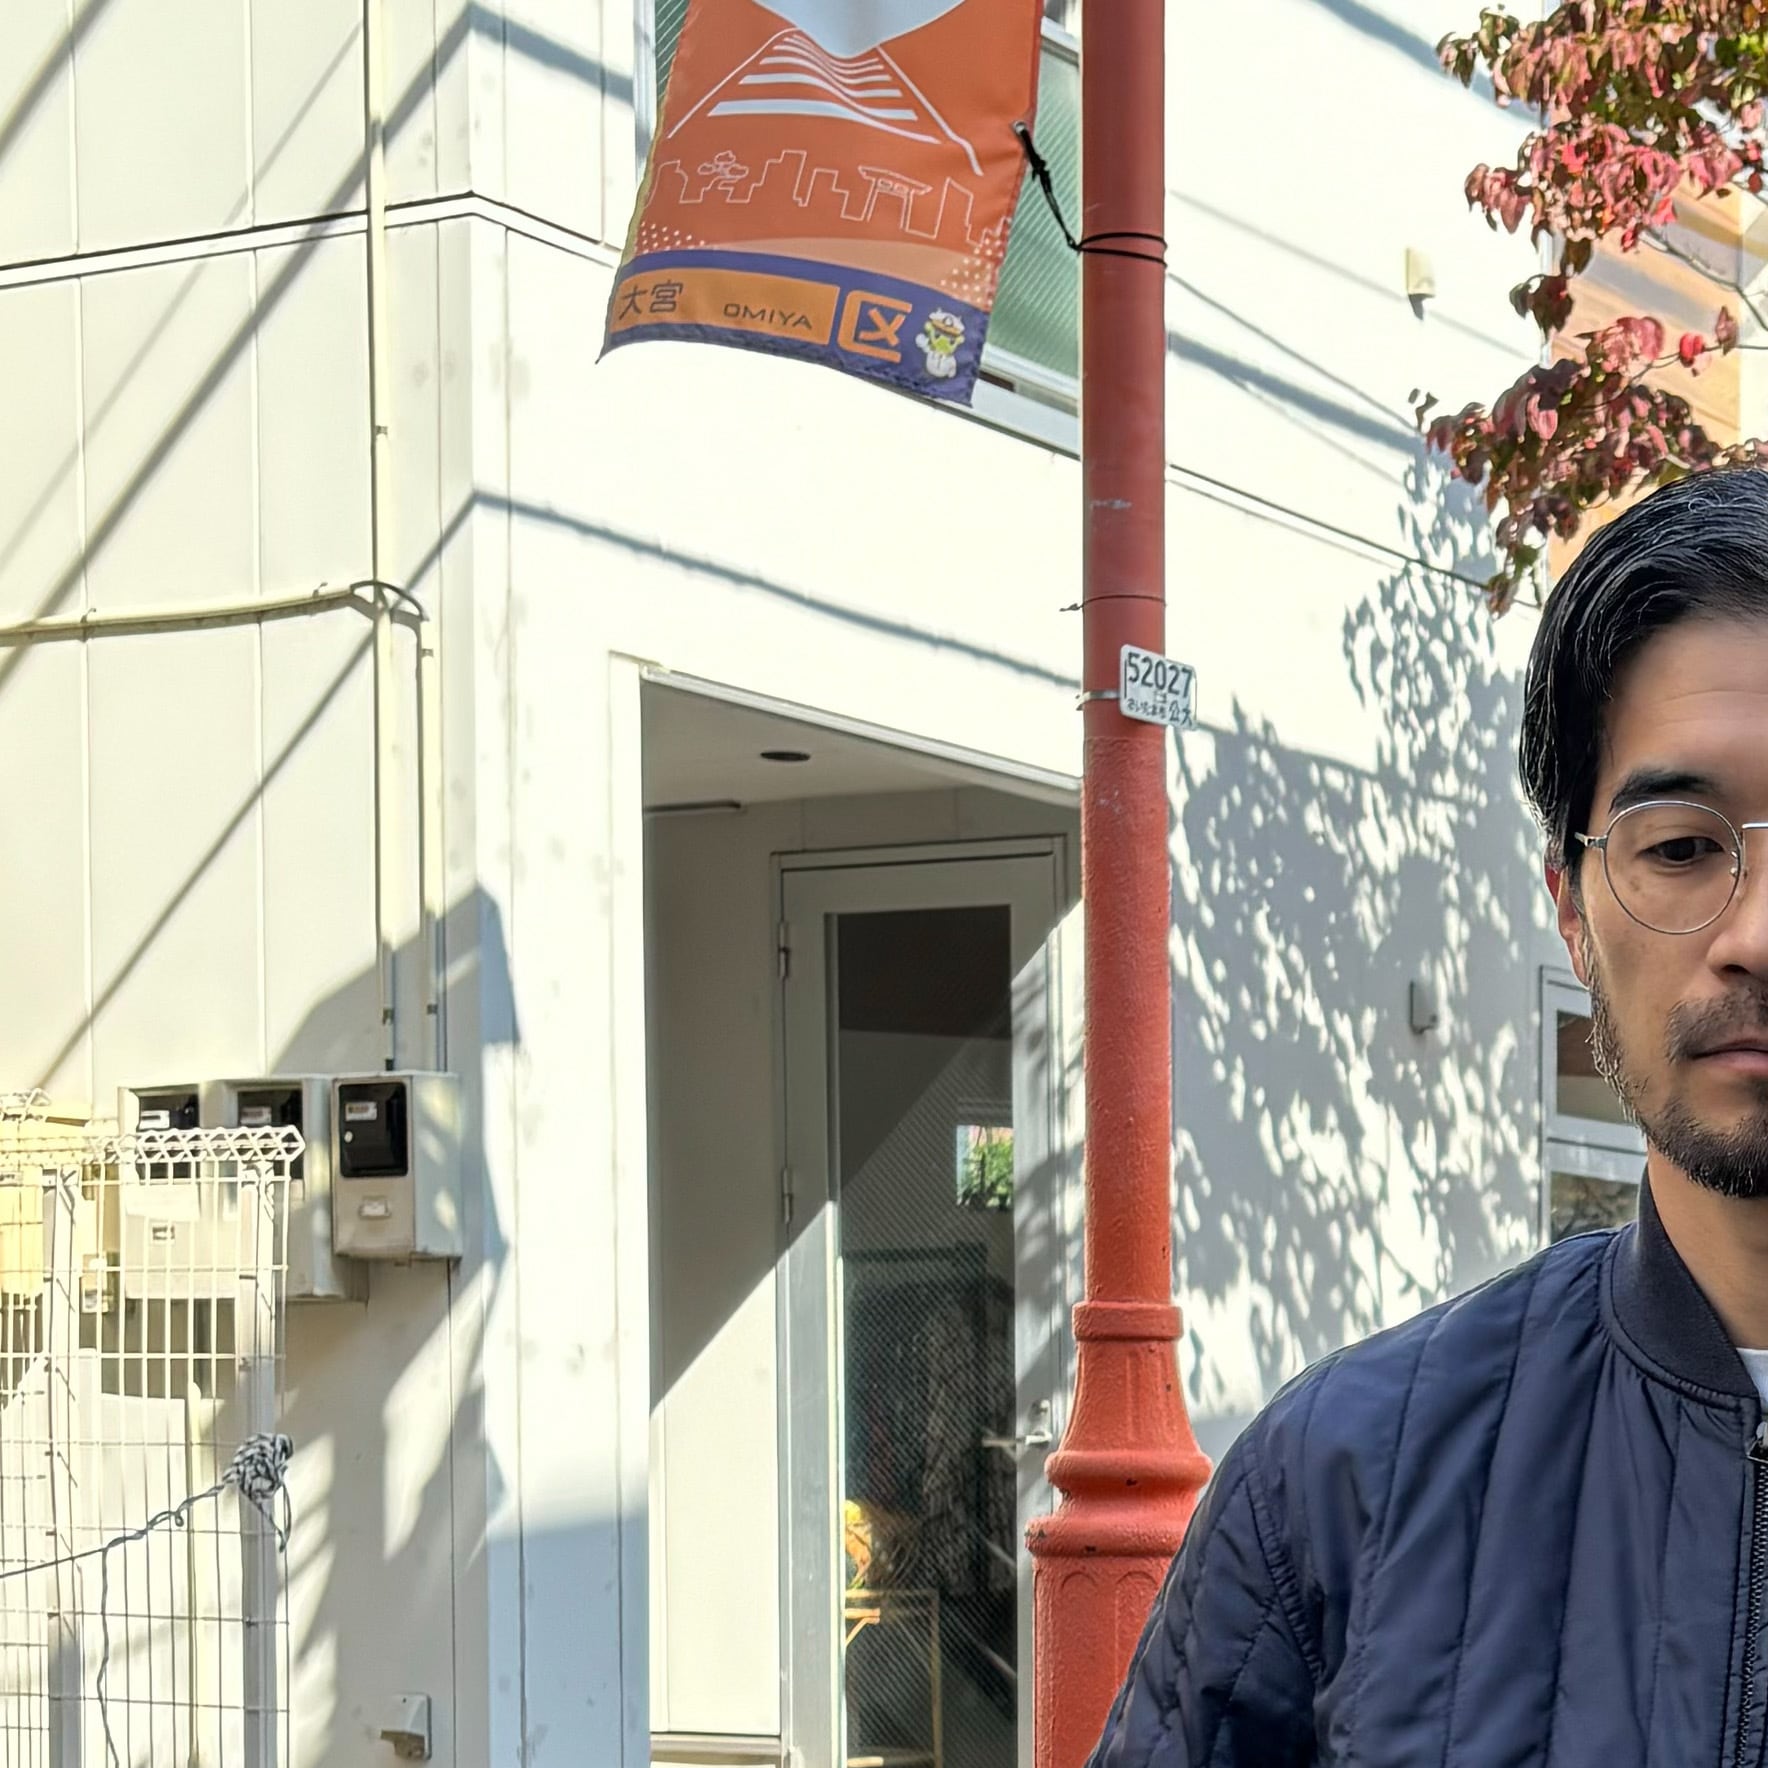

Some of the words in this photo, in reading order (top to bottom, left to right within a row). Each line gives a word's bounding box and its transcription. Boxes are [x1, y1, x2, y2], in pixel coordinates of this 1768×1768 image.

[619, 279, 684, 320] 大宮
[723, 303, 812, 331] OMIYA
[838, 290, 913, 363] 区
[1128, 651, 1192, 698] 52027
